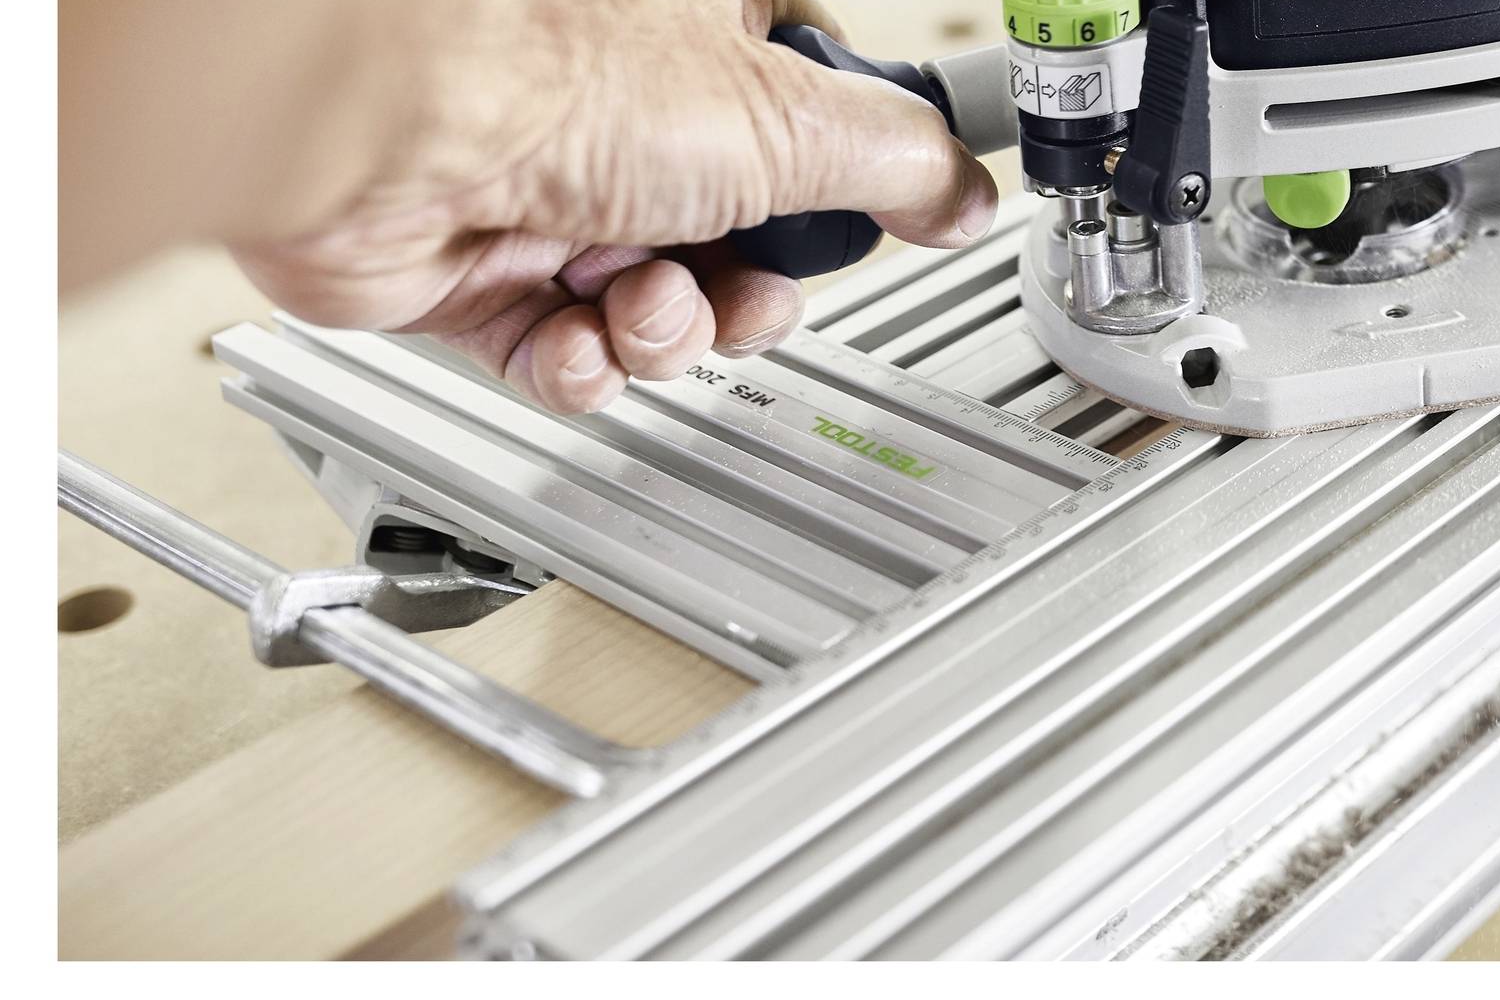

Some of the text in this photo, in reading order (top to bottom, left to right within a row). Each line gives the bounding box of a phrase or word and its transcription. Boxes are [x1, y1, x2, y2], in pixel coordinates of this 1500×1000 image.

[1008, 10, 1129, 43] 4 5 6 7
[685, 364, 776, 407] MFS 200
[810, 415, 937, 480] FESTOOL
[1166, 441, 1181, 450] 23
[1133, 462, 1147, 471] 24
[1098, 483, 1113, 493] 25
